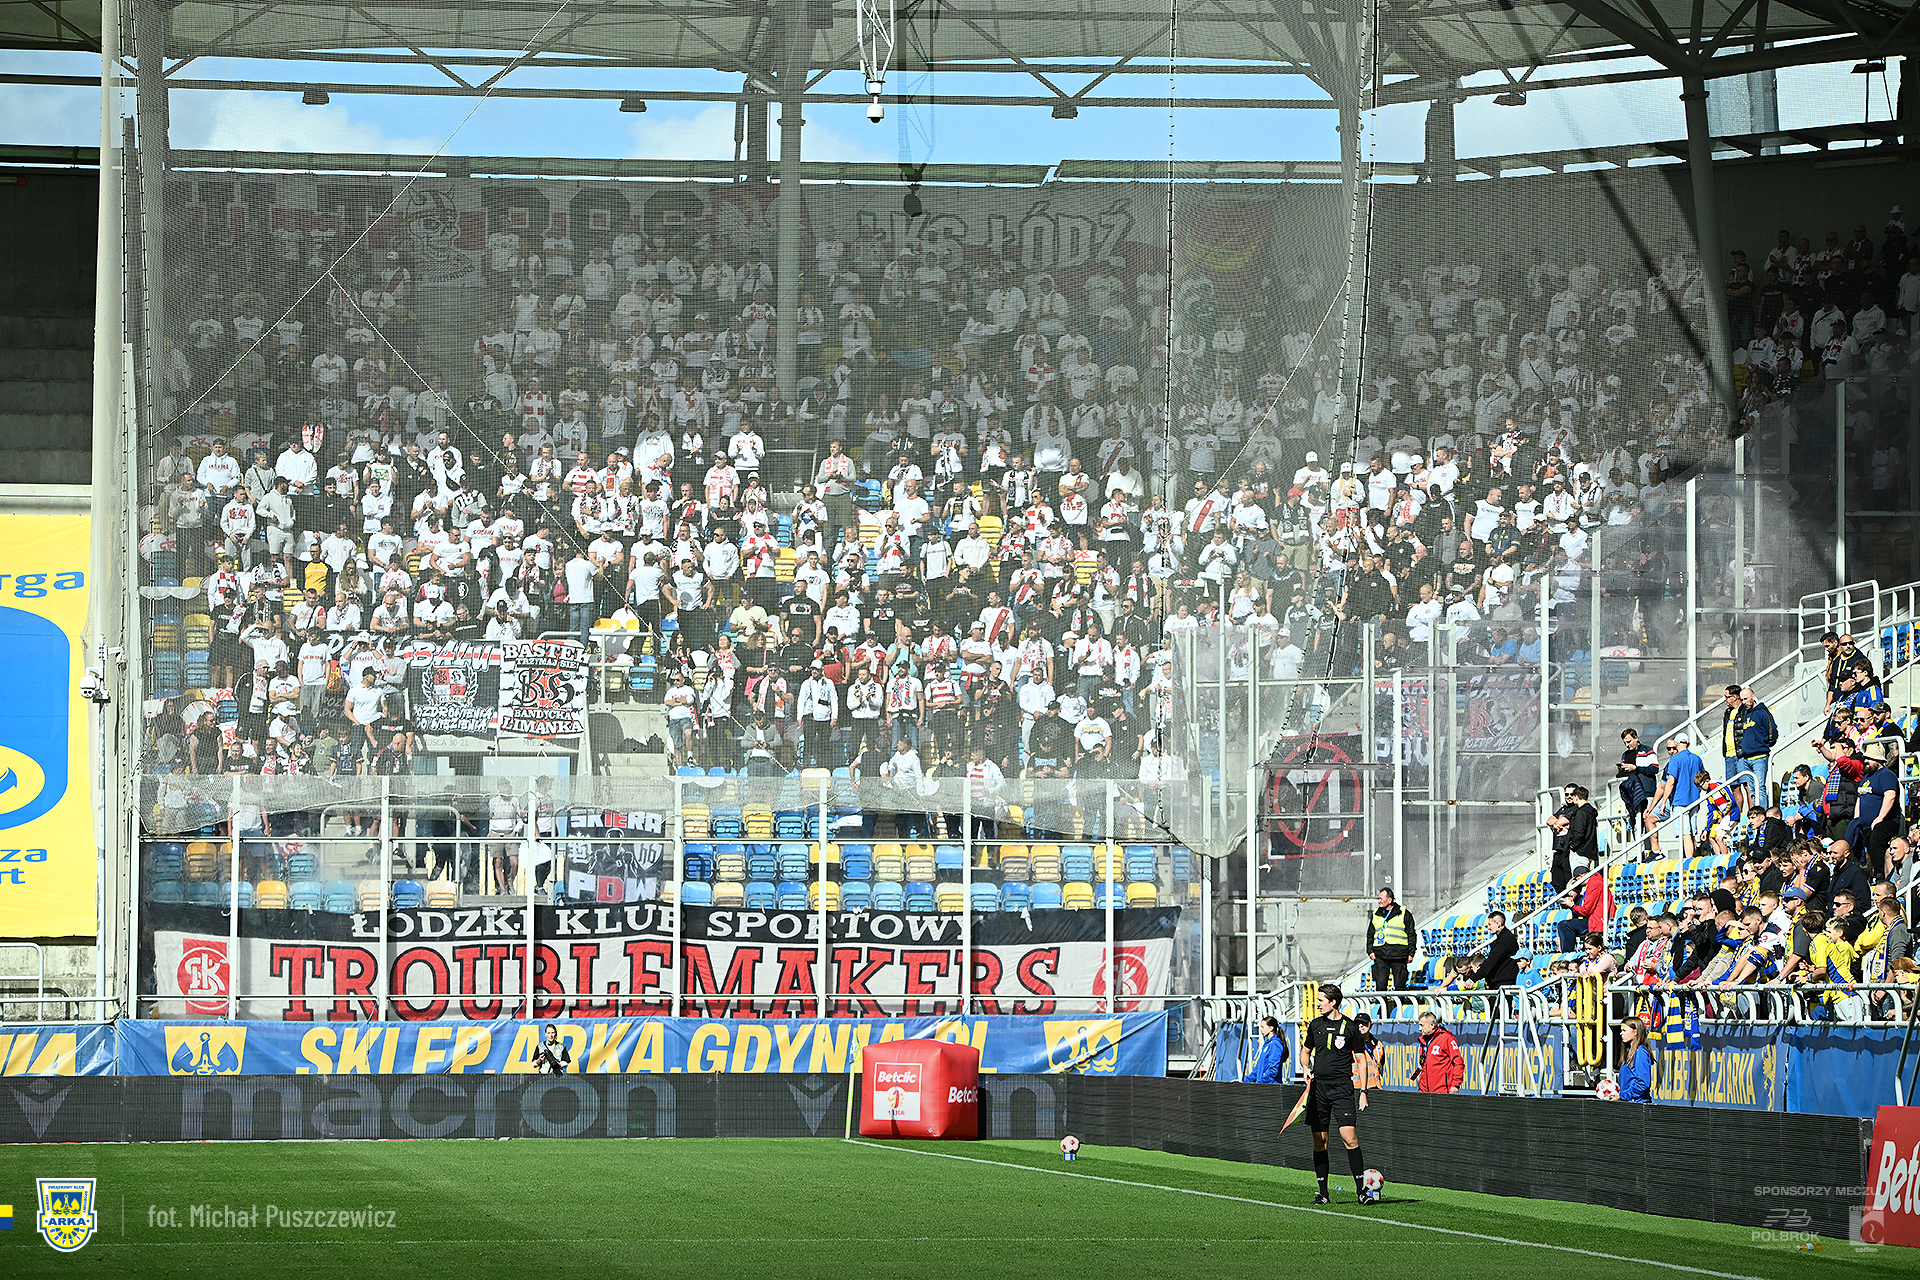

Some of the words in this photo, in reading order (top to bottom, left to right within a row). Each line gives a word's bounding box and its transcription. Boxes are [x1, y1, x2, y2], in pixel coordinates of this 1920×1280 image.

[984, 198, 1135, 272] ŁÓDŹ
[501, 716, 584, 733] LIMANKA
[570, 809, 662, 834] SKIERA
[555, 904, 686, 935] KLUB
[706, 911, 983, 941] SPORTOWY
[270, 942, 1061, 1022] TROUBLEMAKERS
[295, 1022, 997, 1075] SKLEP.ARKA.GDYNIPL
[878, 1071, 917, 1083] Betclic
[948, 1085, 978, 1104] Betclic
[182, 1074, 676, 1139] macron
